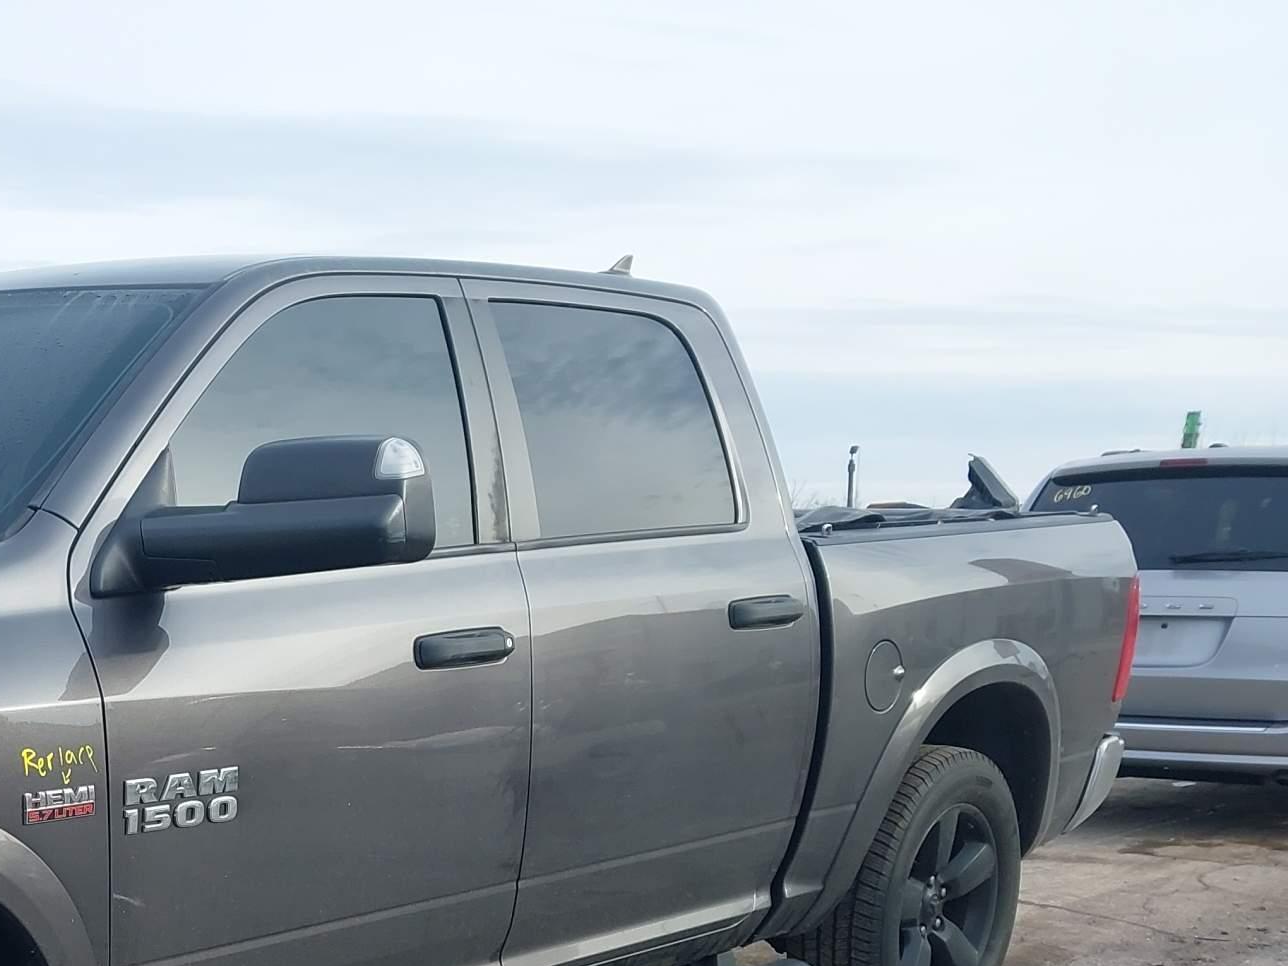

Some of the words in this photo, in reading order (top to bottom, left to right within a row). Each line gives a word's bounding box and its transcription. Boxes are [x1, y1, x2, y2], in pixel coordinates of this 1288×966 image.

[24, 785, 95, 809] HEMI
[124, 766, 239, 806] RAM
[28, 809, 53, 823] 5.7
[55, 804, 94, 817] LITER
[123, 795, 238, 835] 1500
